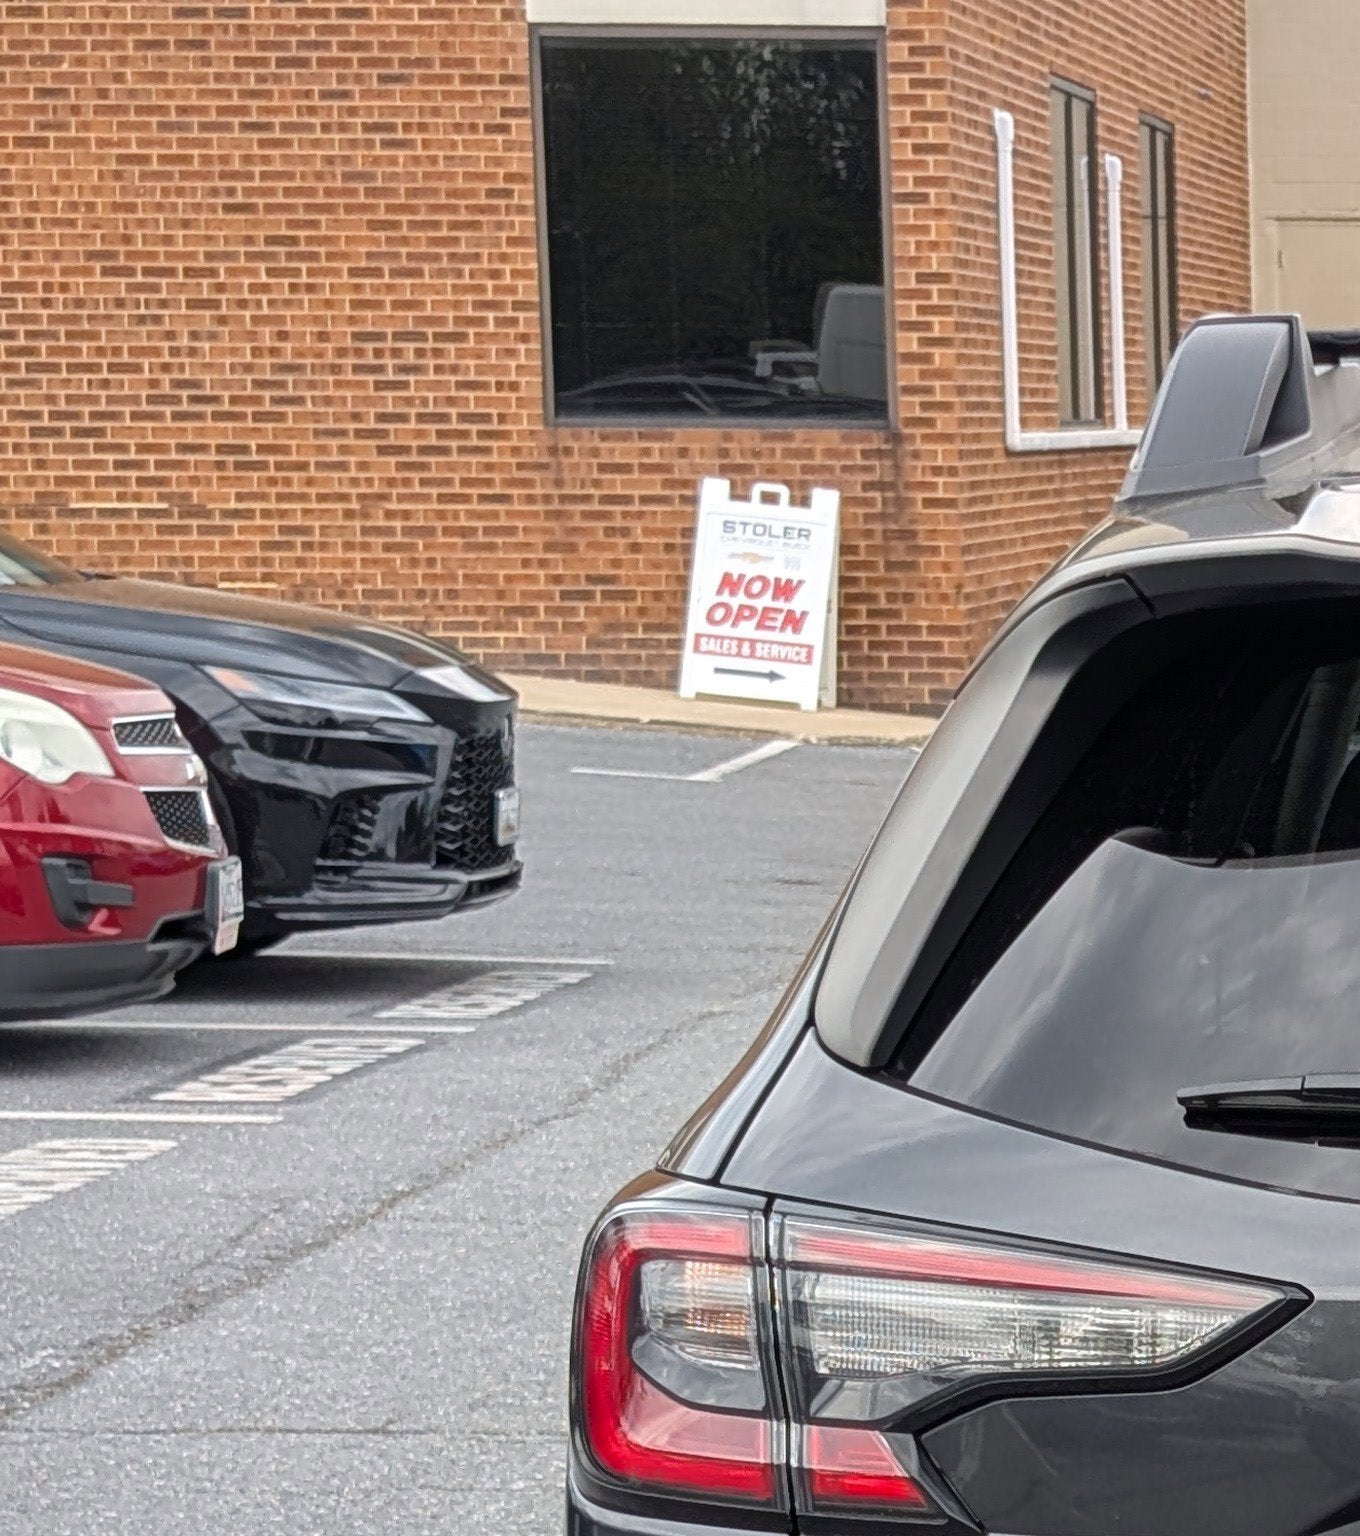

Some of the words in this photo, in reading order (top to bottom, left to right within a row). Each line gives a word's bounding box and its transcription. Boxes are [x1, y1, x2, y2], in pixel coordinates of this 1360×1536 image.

[722, 519, 812, 541] STOLER
[715, 571, 806, 604] NOW
[705, 601, 810, 635] OPEN
[699, 636, 739, 656] SALES
[754, 641, 810, 664] SERVICE
